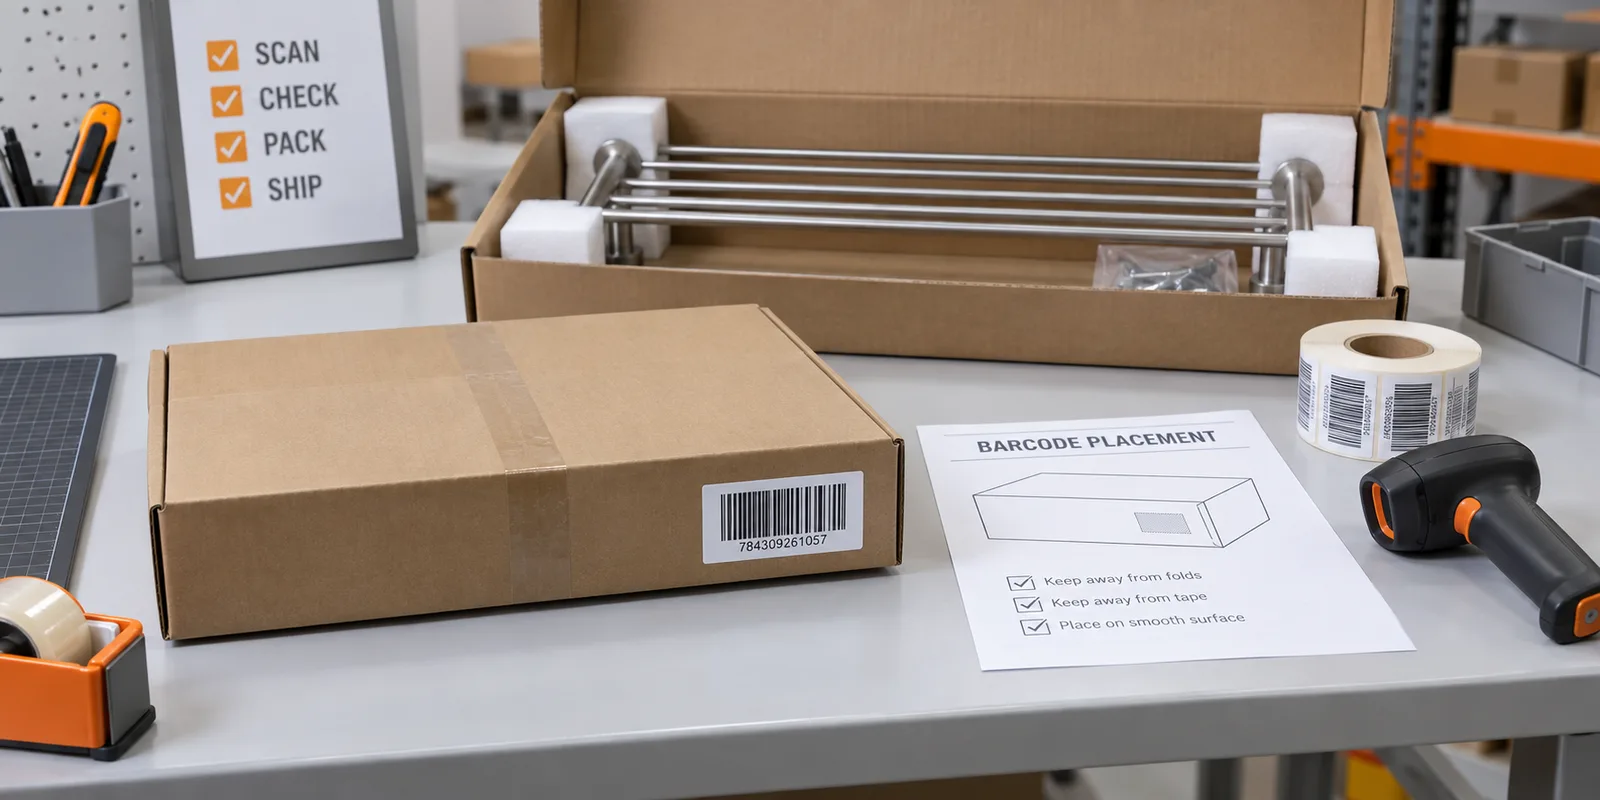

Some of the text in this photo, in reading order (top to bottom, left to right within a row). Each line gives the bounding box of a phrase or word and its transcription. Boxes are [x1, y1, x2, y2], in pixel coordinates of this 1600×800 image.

[255, 39, 320, 66] SCAN
[259, 82, 339, 111] CHECK
[263, 128, 327, 156] PACK
[268, 174, 322, 202] SHIP
[977, 429, 1217, 454] BARCODE PLACEMENT
[739, 534, 827, 552] 784309261057
[1043, 570, 1203, 587] Keep away from folds
[1051, 592, 1208, 608] Keep away from tape
[1059, 612, 1246, 631] Place on smooth surface
